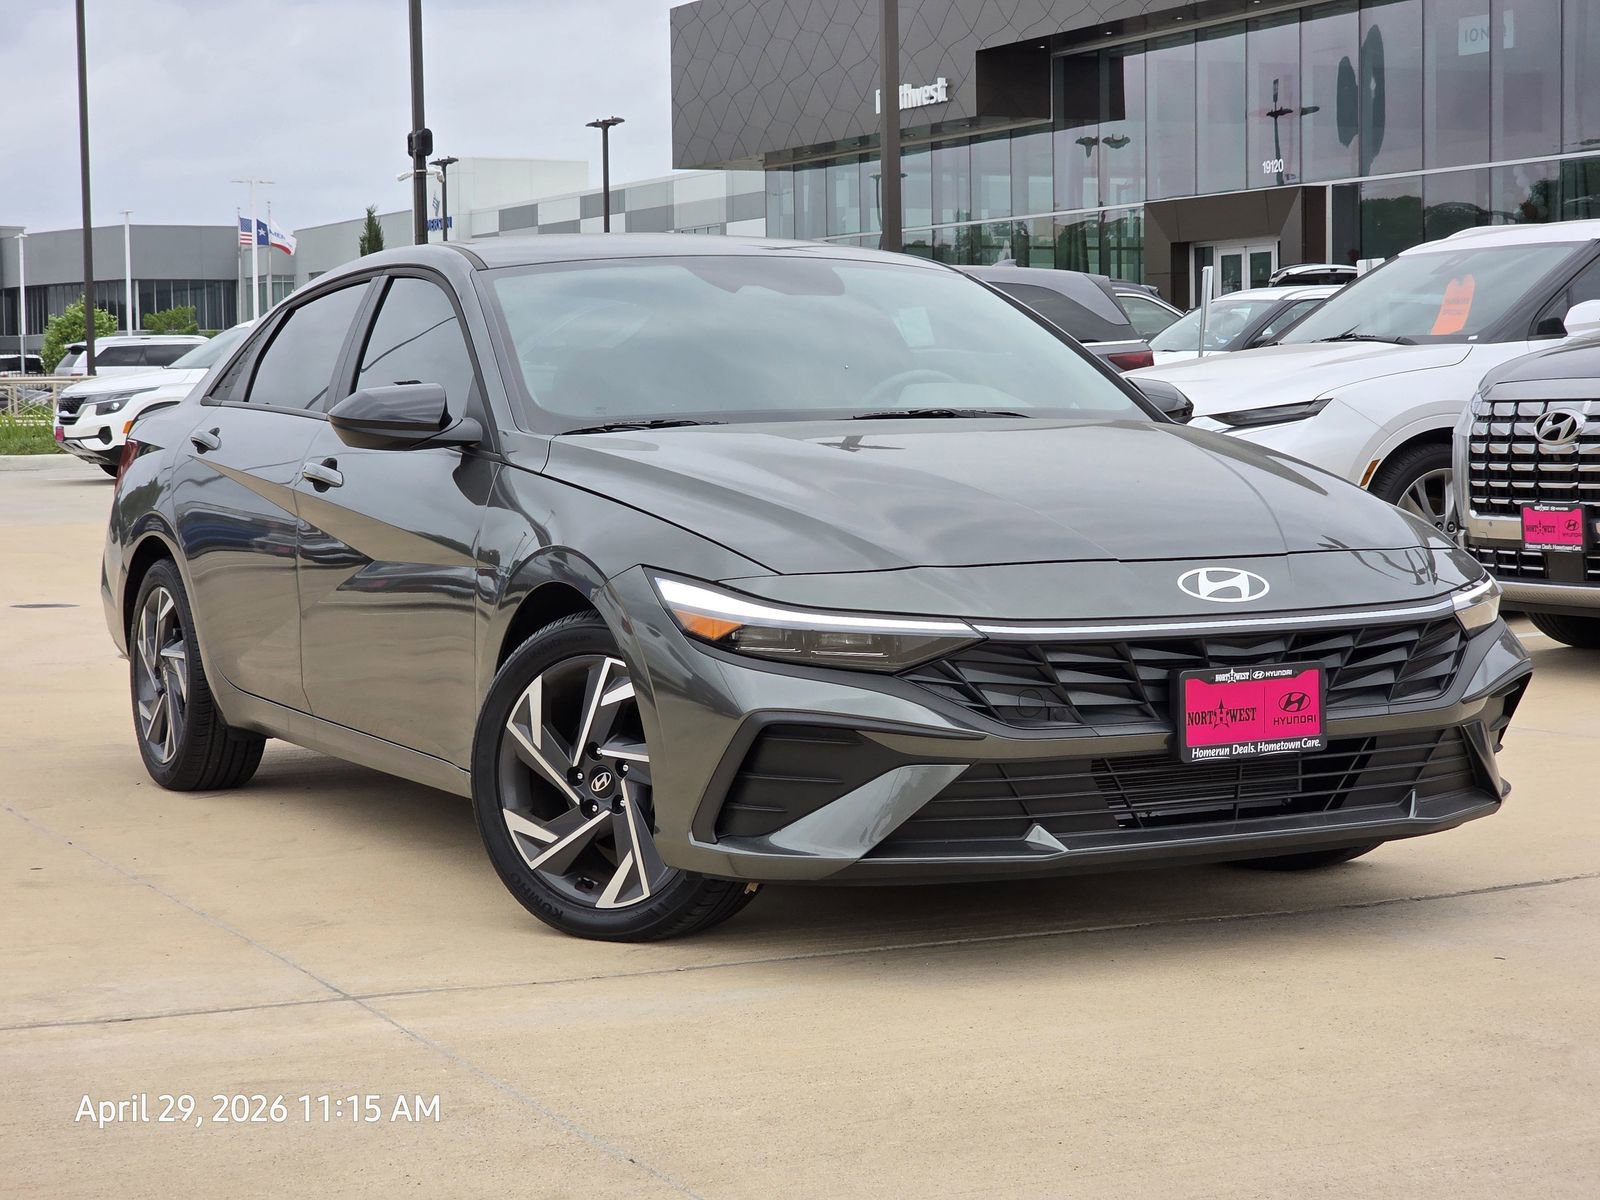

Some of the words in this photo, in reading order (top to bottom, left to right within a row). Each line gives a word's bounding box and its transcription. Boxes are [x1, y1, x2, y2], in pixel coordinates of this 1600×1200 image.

[1262, 158, 1284, 174] 19120
[1265, 669, 1293, 677] HYUNDAI
[1273, 714, 1317, 726] HYUNDAI
[1191, 747, 1230, 759] Homerun
[1232, 744, 1256, 755] Deals.
[1257, 740, 1301, 752] Hometown
[1301, 738, 1321, 748] Care.
